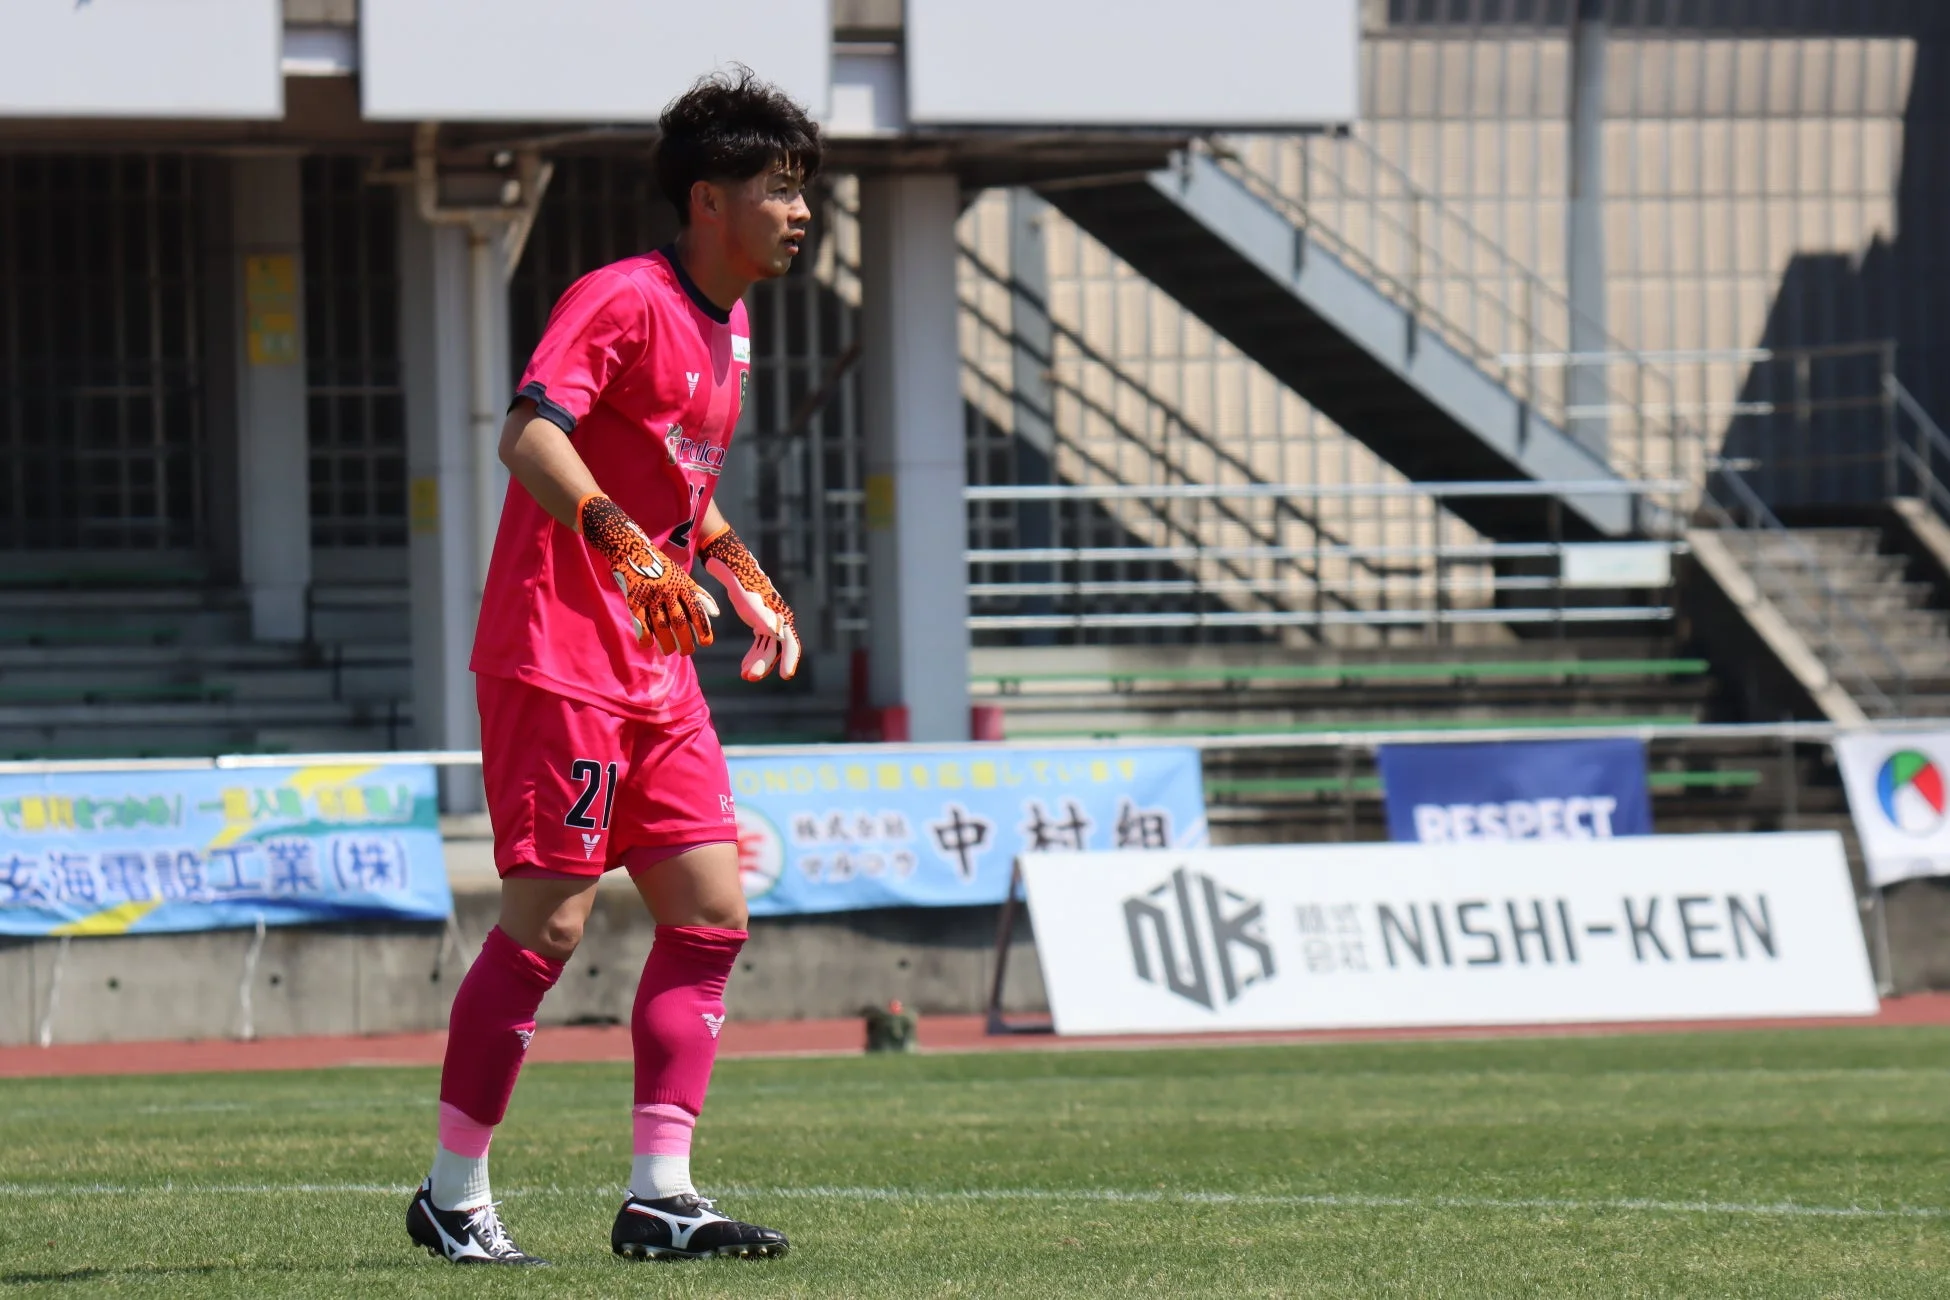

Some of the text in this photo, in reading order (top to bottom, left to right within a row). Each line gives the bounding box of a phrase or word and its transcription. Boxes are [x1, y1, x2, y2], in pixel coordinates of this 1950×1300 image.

[565, 759, 618, 831] 21
[1413, 796, 1617, 843] RESPECT
[934, 802, 1168, 877] 中村組
[1377, 894, 1778, 967] NISHI-KEN
